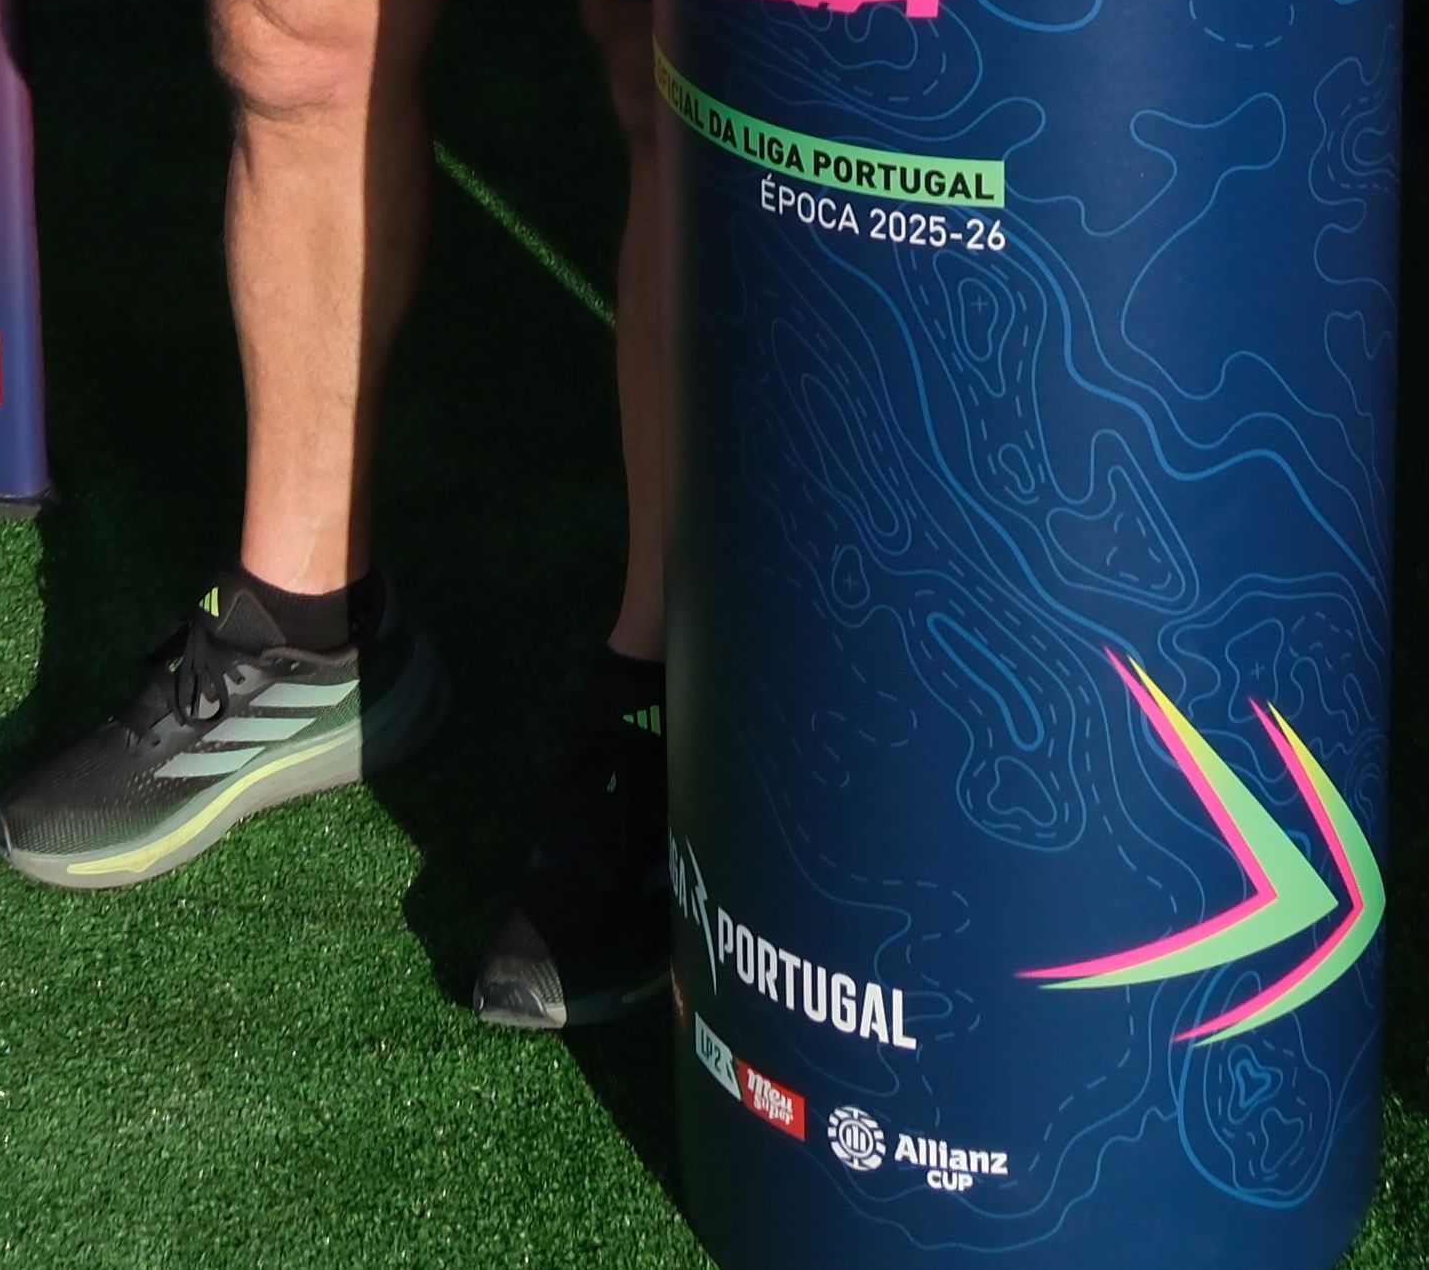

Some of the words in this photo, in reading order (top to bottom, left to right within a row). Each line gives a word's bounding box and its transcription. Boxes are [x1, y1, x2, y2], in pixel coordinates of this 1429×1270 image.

[709, 109, 738, 148] DA
[743, 126, 805, 173] LIGA
[813, 149, 995, 201] PORTUGAL
[760, 173, 860, 236] ÉPOCA
[869, 209, 1006, 251] 2025-26
[717, 906, 917, 1049] PORTUGAL
[701, 1028, 722, 1064] LP2
[894, 1133, 1009, 1176] Allianz
[926, 1170, 974, 1192] CUP
